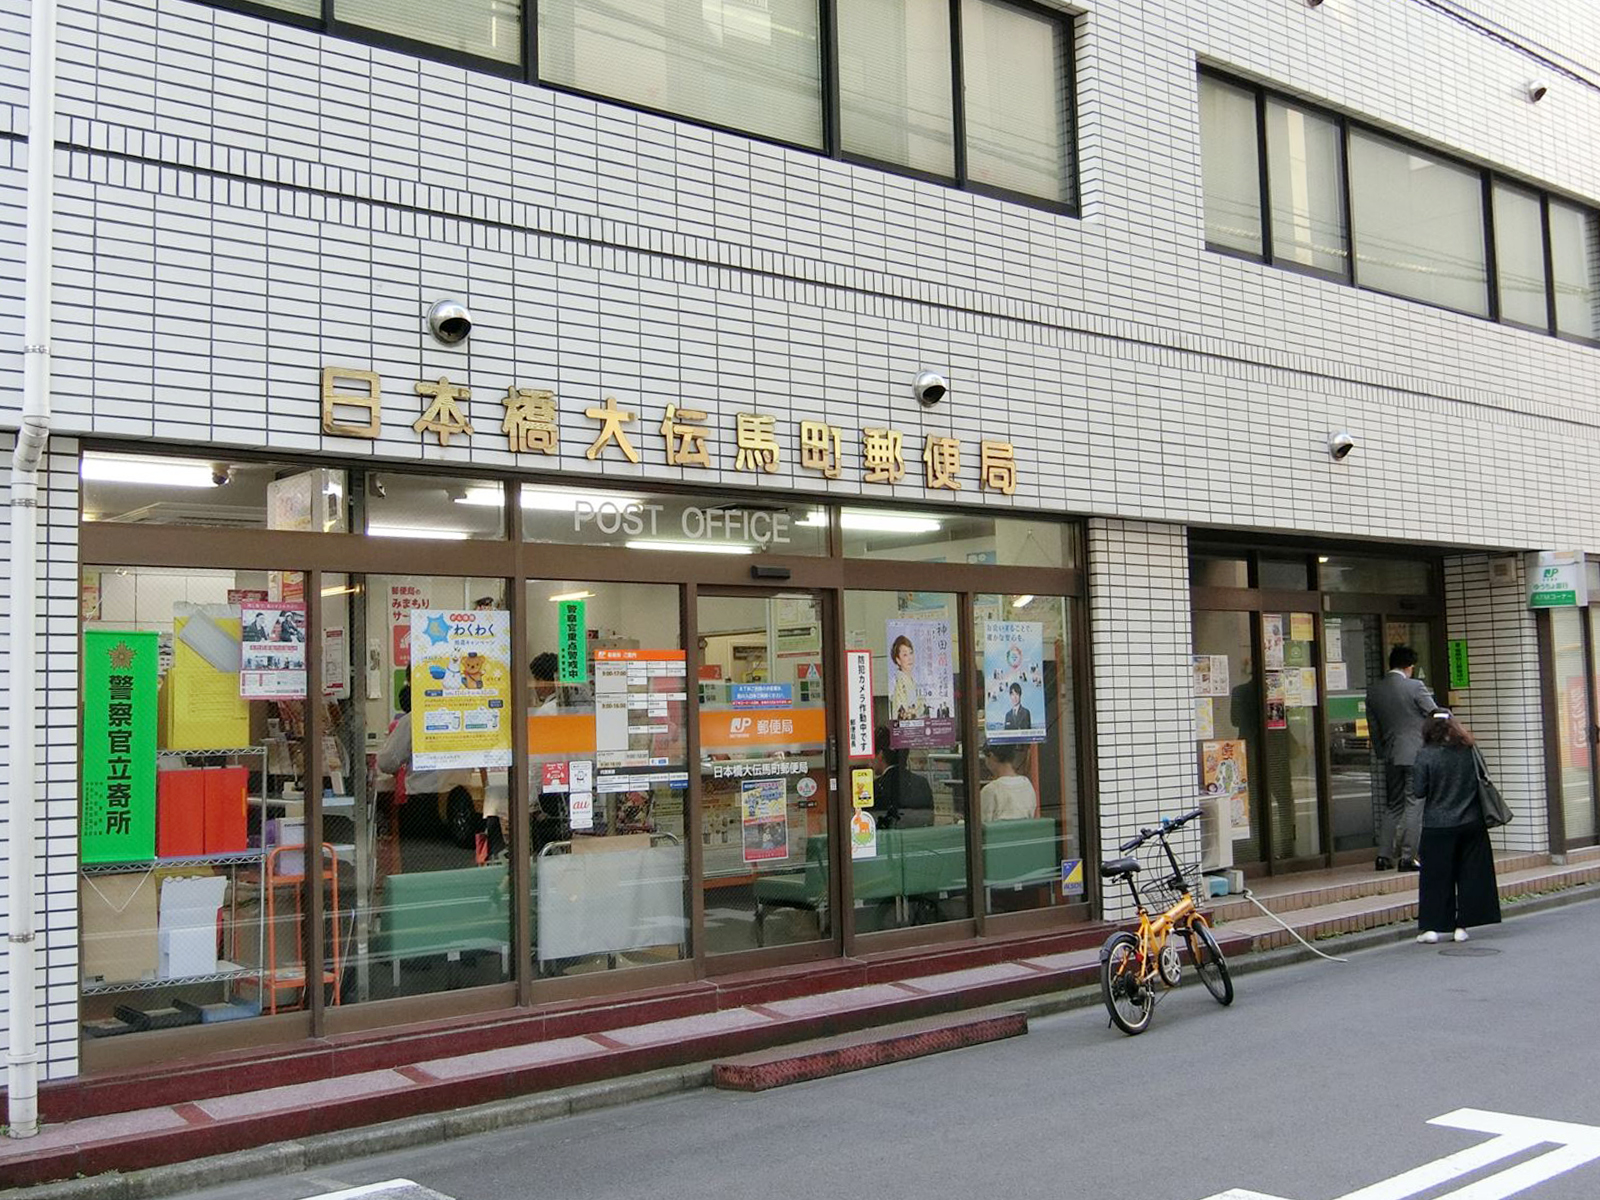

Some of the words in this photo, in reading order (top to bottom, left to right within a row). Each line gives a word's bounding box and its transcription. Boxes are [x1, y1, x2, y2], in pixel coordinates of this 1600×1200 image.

[321, 367, 1017, 495] 日本橋大伝馬町郵便局
[575, 501, 663, 535] POST
[681, 507, 791, 543] OFFICE
[393, 598, 429, 609] みまもり
[454, 623, 494, 636] わくわく
[858, 655, 868, 751] 防犯カメラ作動中です
[757, 719, 793, 734] 郵便局
[106, 674, 134, 835] 警察官立寄所
[714, 762, 808, 778] 日本橋大伝馬町郵便局
[574, 801, 590, 810] au
